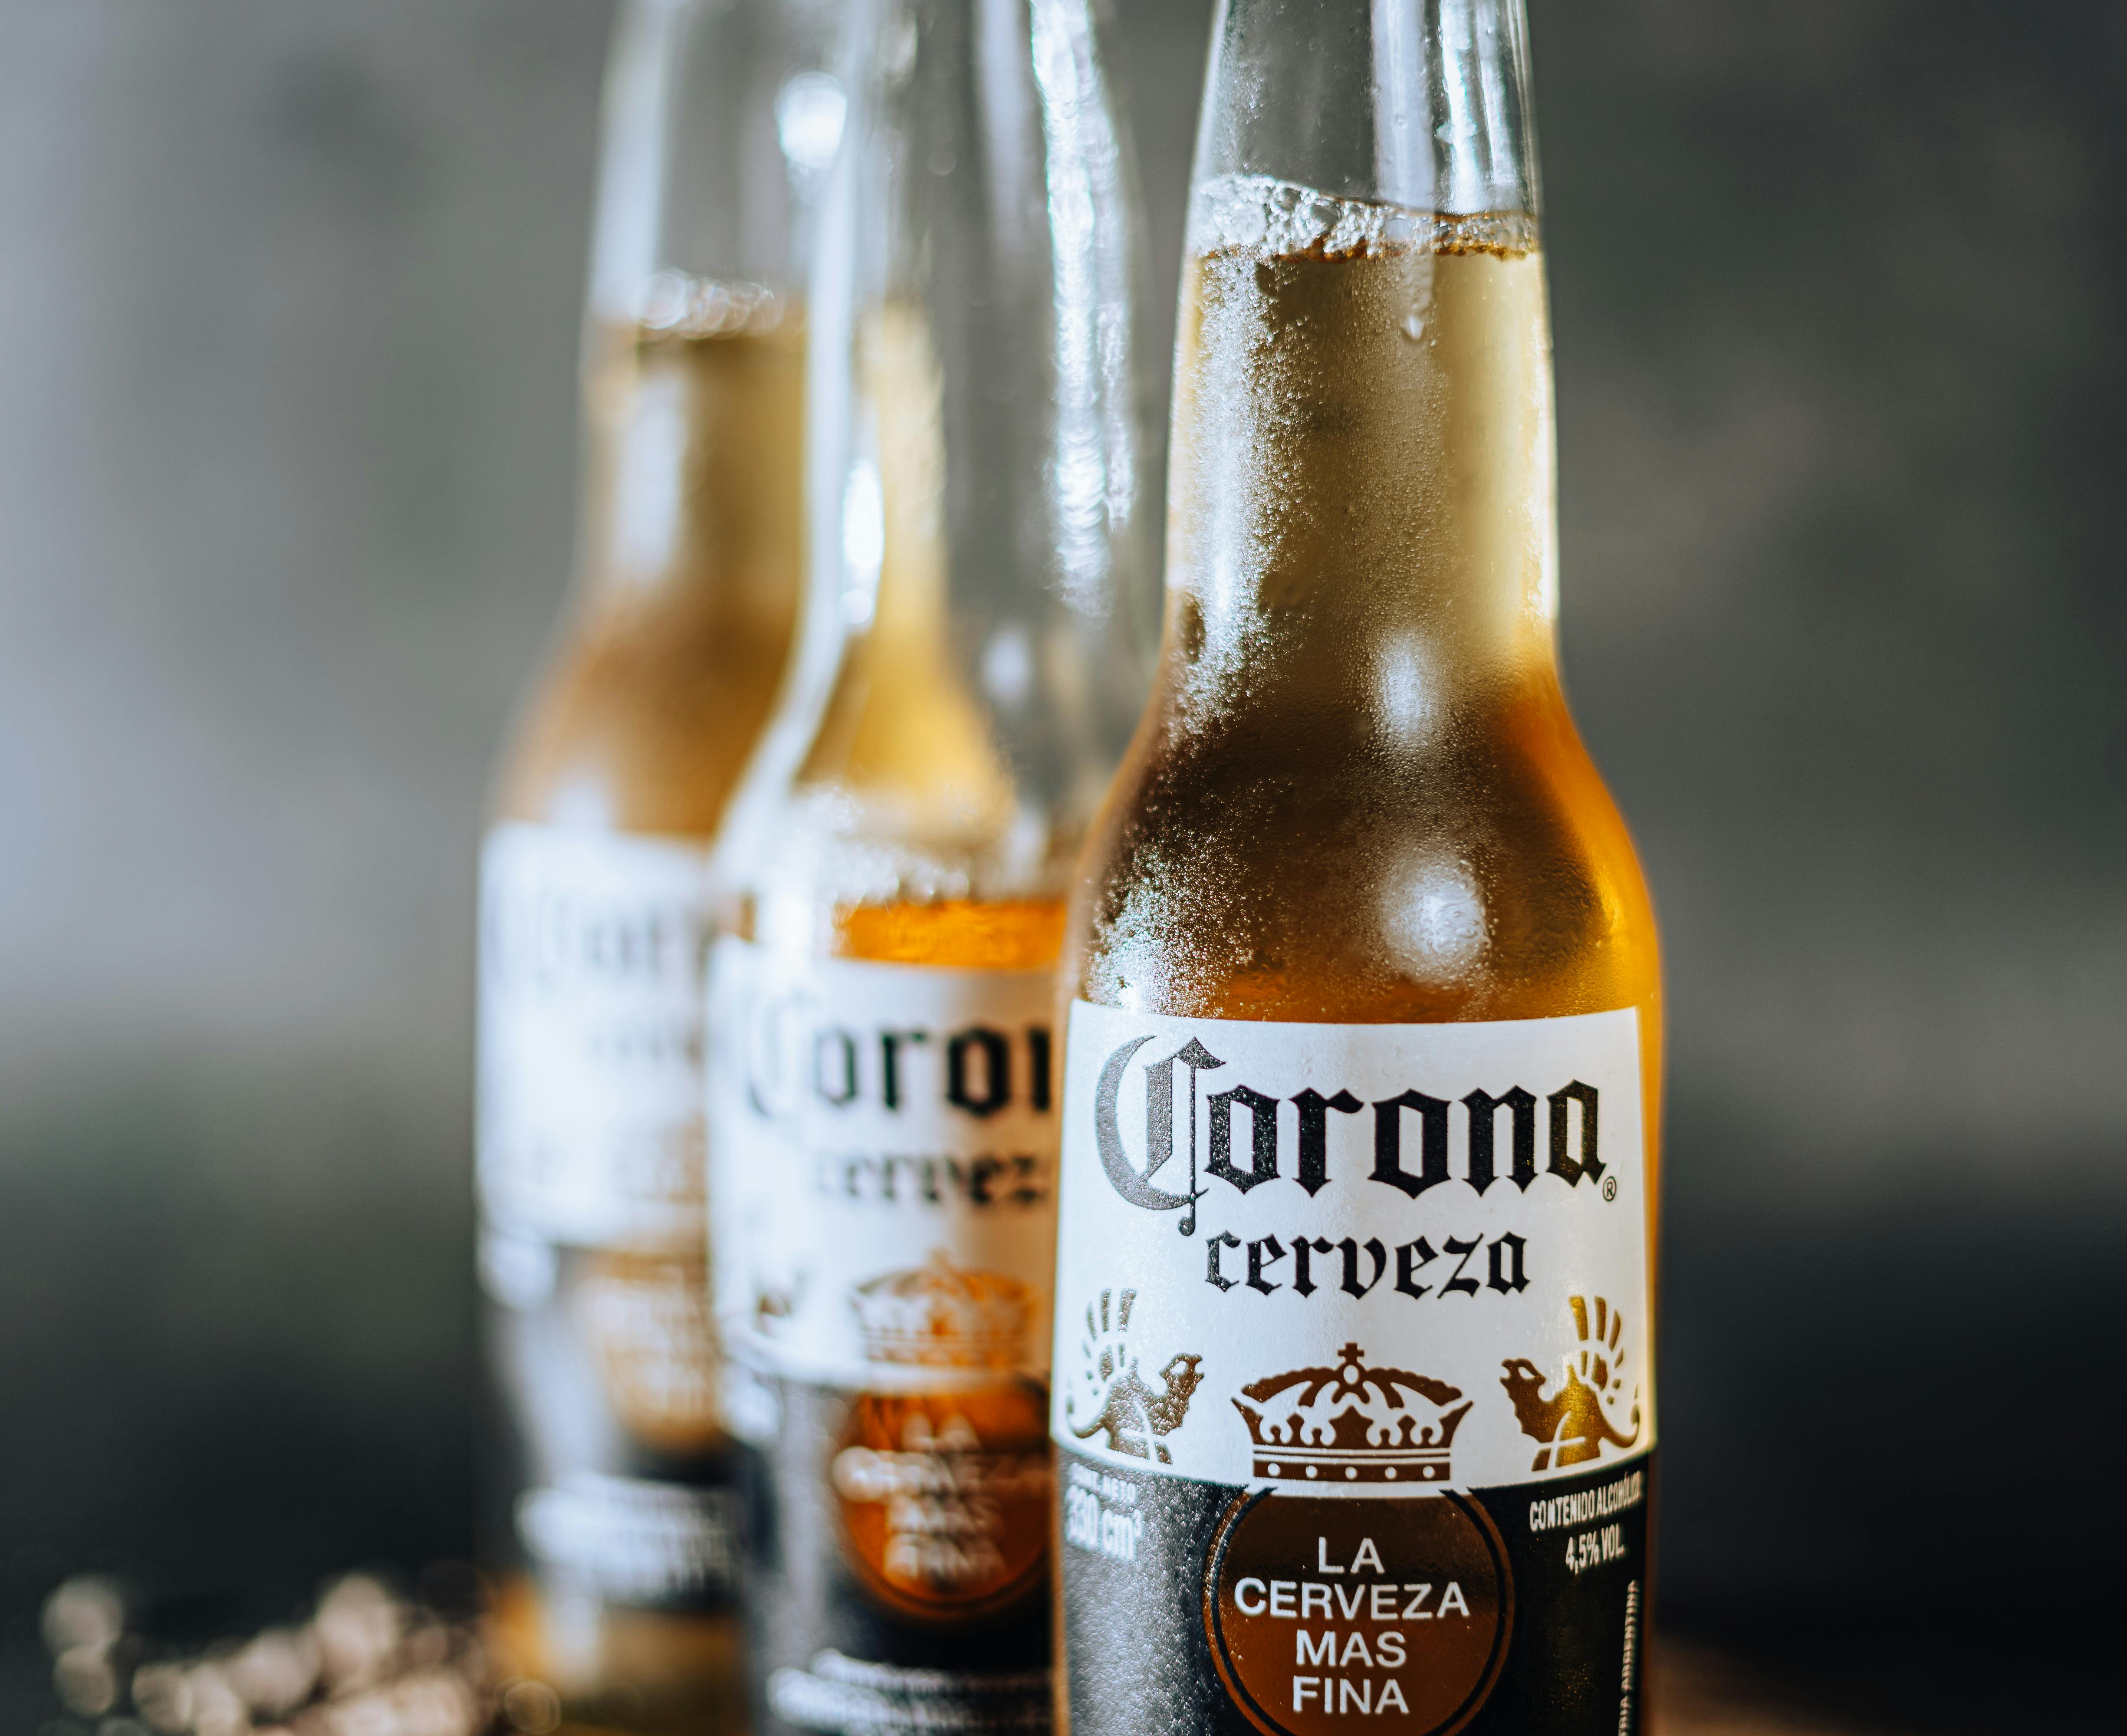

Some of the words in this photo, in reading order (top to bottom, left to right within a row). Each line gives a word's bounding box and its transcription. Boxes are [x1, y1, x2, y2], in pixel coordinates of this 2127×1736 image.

[1095, 1035, 1606, 1236] Corona
[1205, 1230, 1530, 1299] cerveza
[1529, 1489, 1595, 1532] CONTENIDO
[1318, 1537, 1384, 1573] LA
[1565, 1531, 1600, 1575] 4,5%
[1601, 1523, 1626, 1562] VOL.
[1234, 1577, 1470, 1620] CERVEZA
[1296, 1629, 1407, 1668] MAS
[1293, 1675, 1410, 1714] FINA
